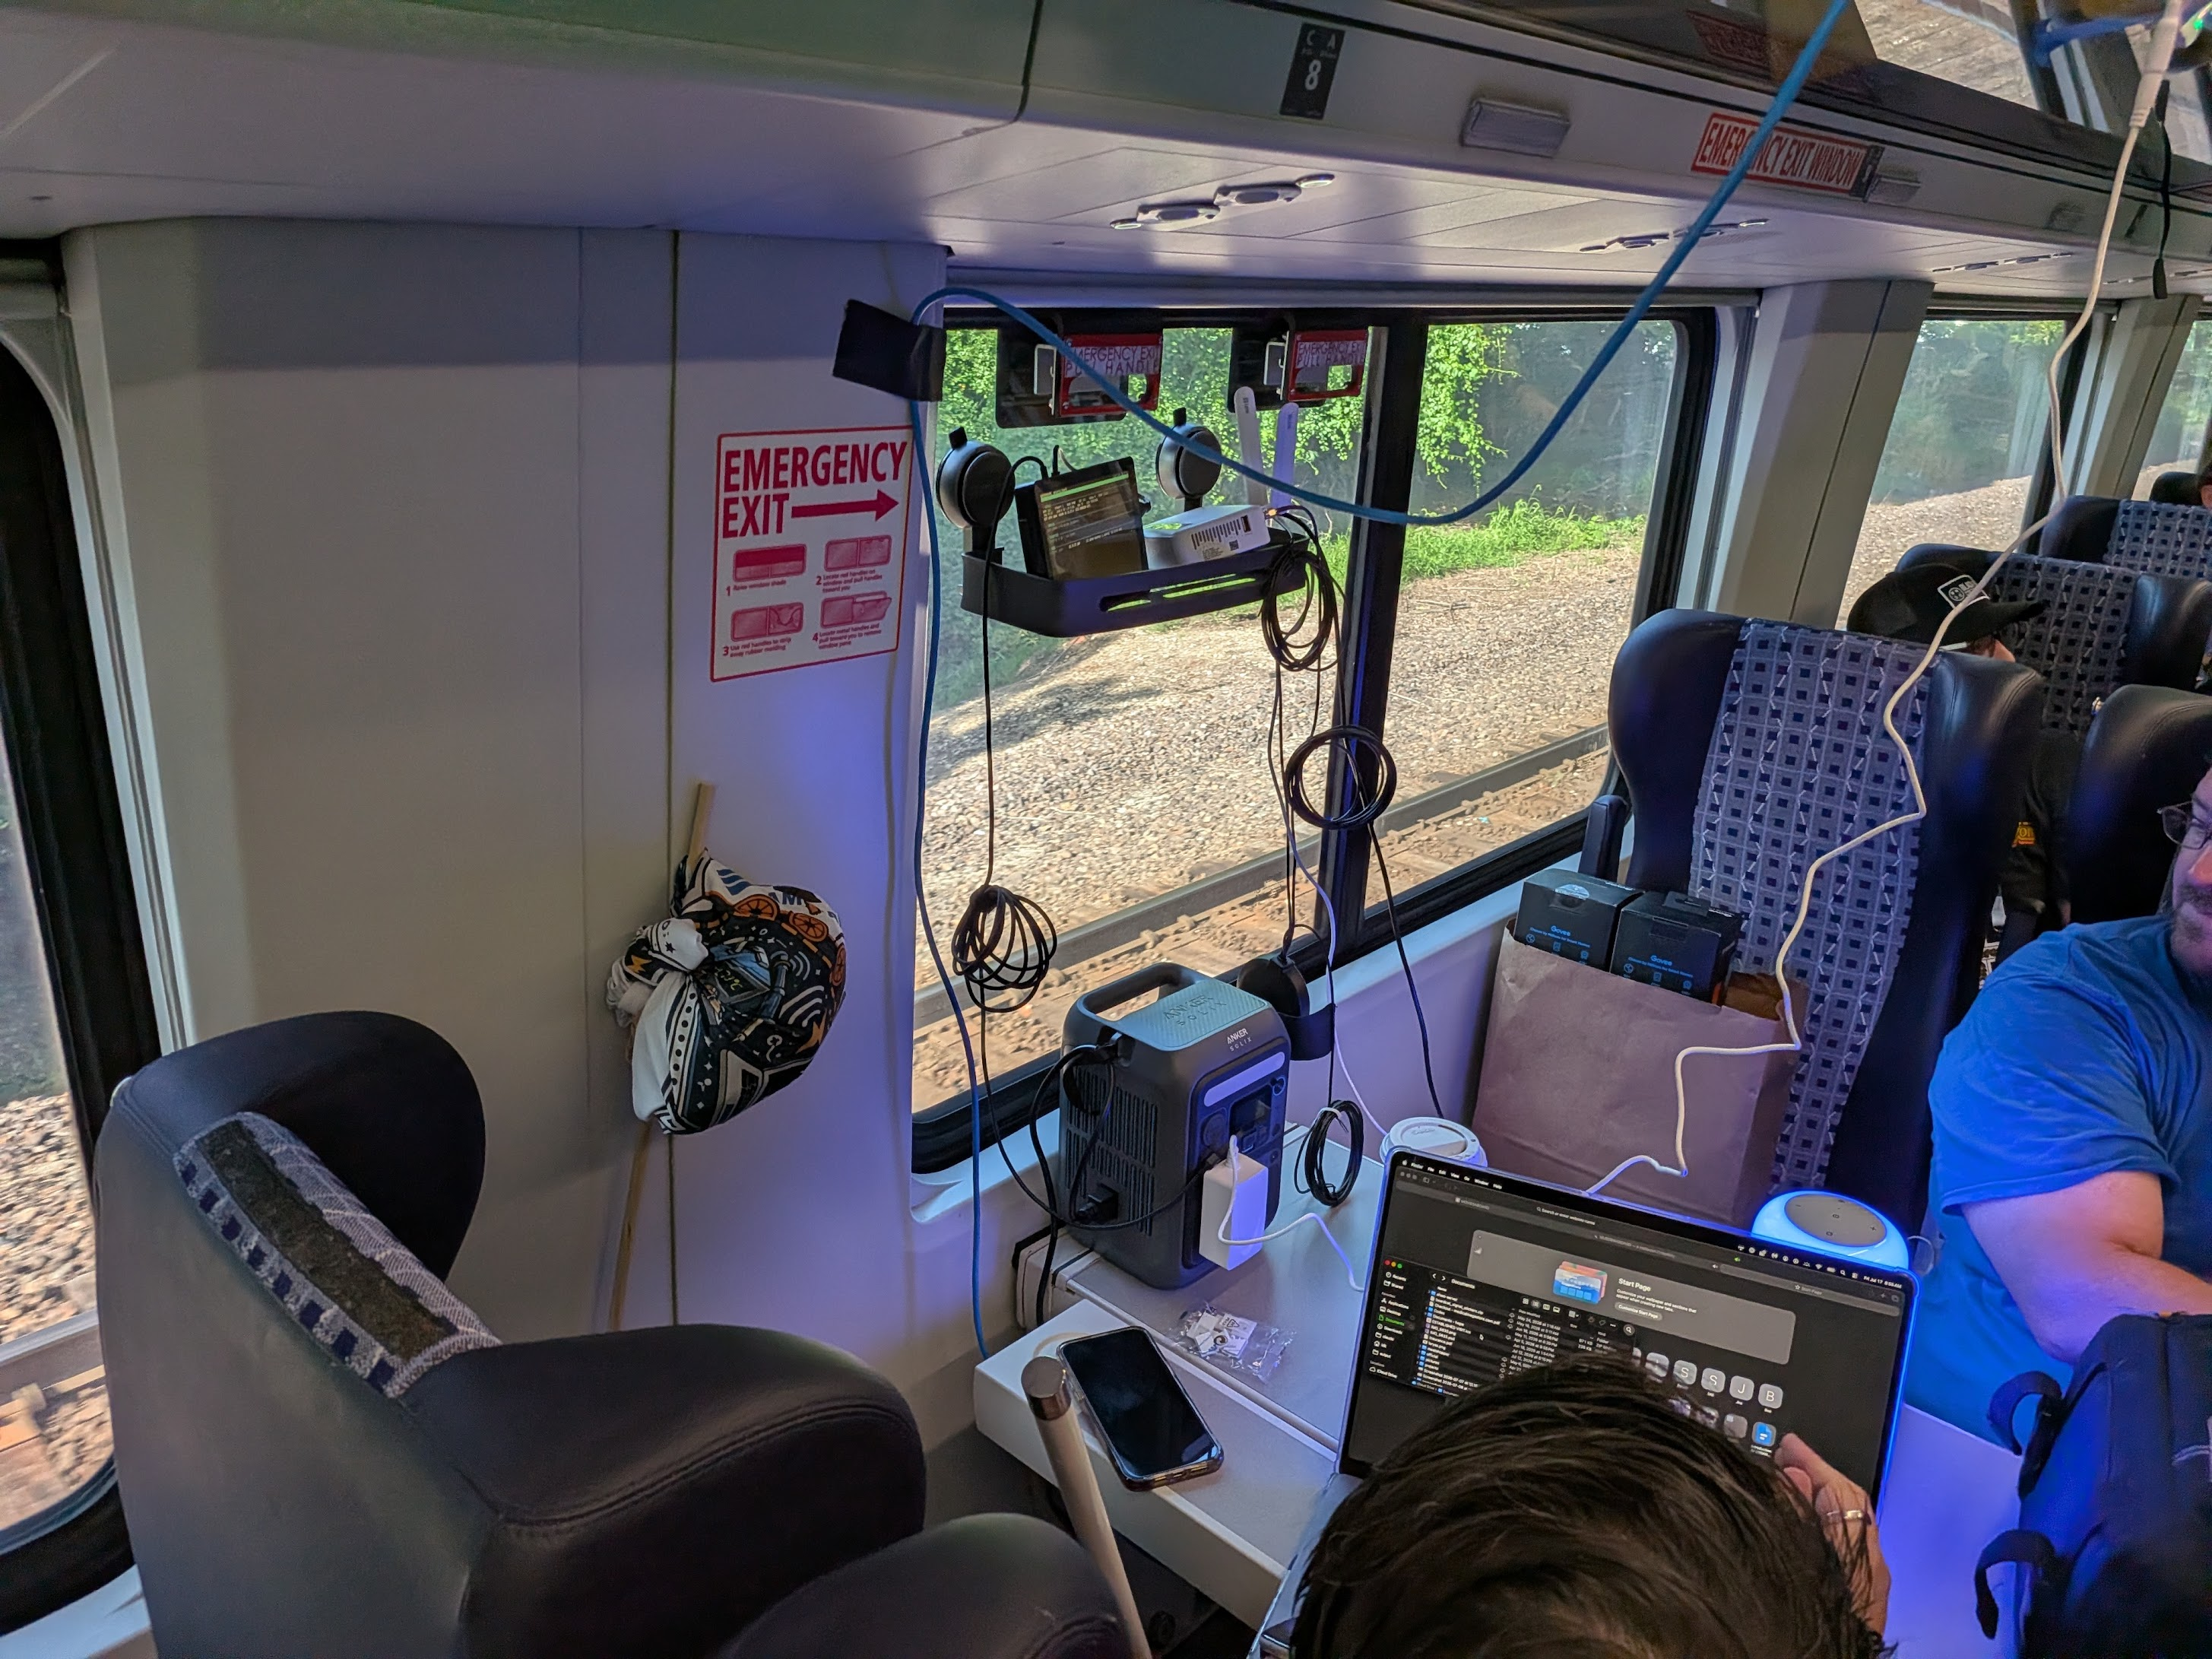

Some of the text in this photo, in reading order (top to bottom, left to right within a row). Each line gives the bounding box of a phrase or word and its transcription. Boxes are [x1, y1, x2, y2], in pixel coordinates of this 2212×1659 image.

[1307, 30, 1336, 49] C A
[1304, 59, 1321, 90] 8
[1697, 122, 1786, 175] EMERNCY
[1779, 138, 1817, 177] EXIT
[1808, 142, 1863, 188] WINDOW
[1299, 341, 1348, 354] EMERGENCY
[1073, 347, 1139, 362] MERGENCY
[724, 441, 907, 493] EMERGENCY
[722, 493, 790, 538] EXIT
[816, 576, 822, 585] 2
[726, 585, 730, 596] 1
[812, 632, 819, 642] 4
[723, 646, 729, 656] 3
[1551, 925, 1571, 937] Govee
[1650, 955, 1672, 966] Govee
[1163, 995, 1214, 1020] ANKER
[1175, 1003, 1227, 1026] SOLIX
[1227, 1028, 1248, 1045] ANKER
[1229, 1036, 1252, 1052] SOLIX
[1451, 1279, 1475, 1289] Documents
[1618, 1277, 1651, 1292] Start Page
[1388, 1299, 1409, 1309] Applications
[1617, 1289, 1637, 1297] Customize
[1646, 1296, 1664, 1305] wallpaper
[1672, 1303, 1688, 1312] sections
[1640, 1299, 1656, 1308] creating
[1618, 1304, 1638, 1314] Customize
[1385, 1317, 1405, 1326] Documents
[1383, 1326, 1403, 1334] Downloads
[1680, 1367, 1689, 1378] S
[1710, 1375, 1718, 1385] S
[1738, 1383, 1745, 1394] J
[1766, 1391, 1775, 1401] B
